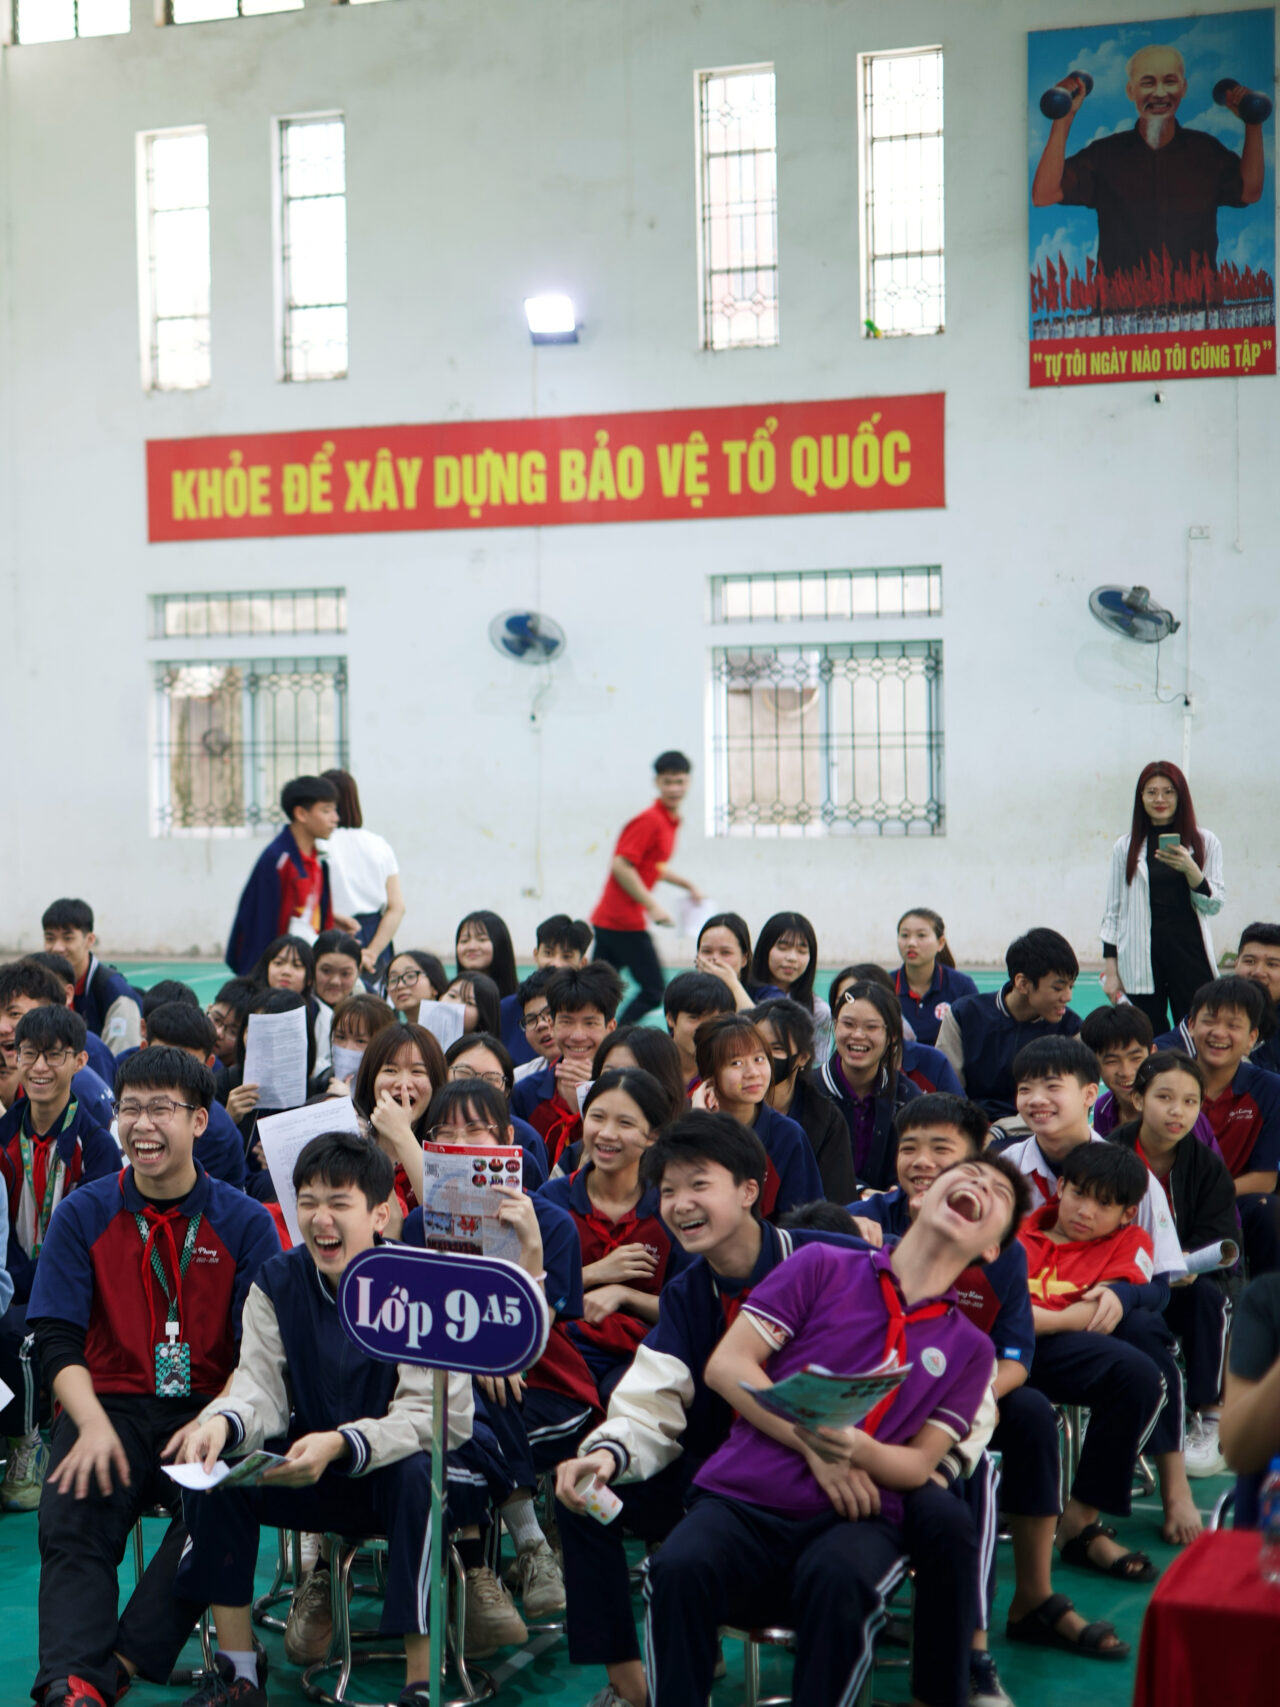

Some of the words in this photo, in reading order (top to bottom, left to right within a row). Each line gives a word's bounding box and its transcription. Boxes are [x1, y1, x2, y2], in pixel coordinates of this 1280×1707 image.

[1065, 347, 1087, 377] TÔI
[1090, 346, 1129, 376] NGÀY
[1131, 344, 1161, 373] NÀO
[1164, 342, 1187, 371] TÔI
[1191, 341, 1230, 370] CŨNG
[171, 450, 271, 520] KHỎE
[281, 441, 334, 515] ĐỂ
[344, 447, 422, 512] XÂY
[434, 447, 547, 518] DỰNG
[559, 430, 644, 502] BẢO
[656, 431, 710, 508] VỆ
[722, 416, 778, 493] TỔ
[790, 412, 911, 497] QUỐC
[355, 1276, 433, 1349] Lớp
